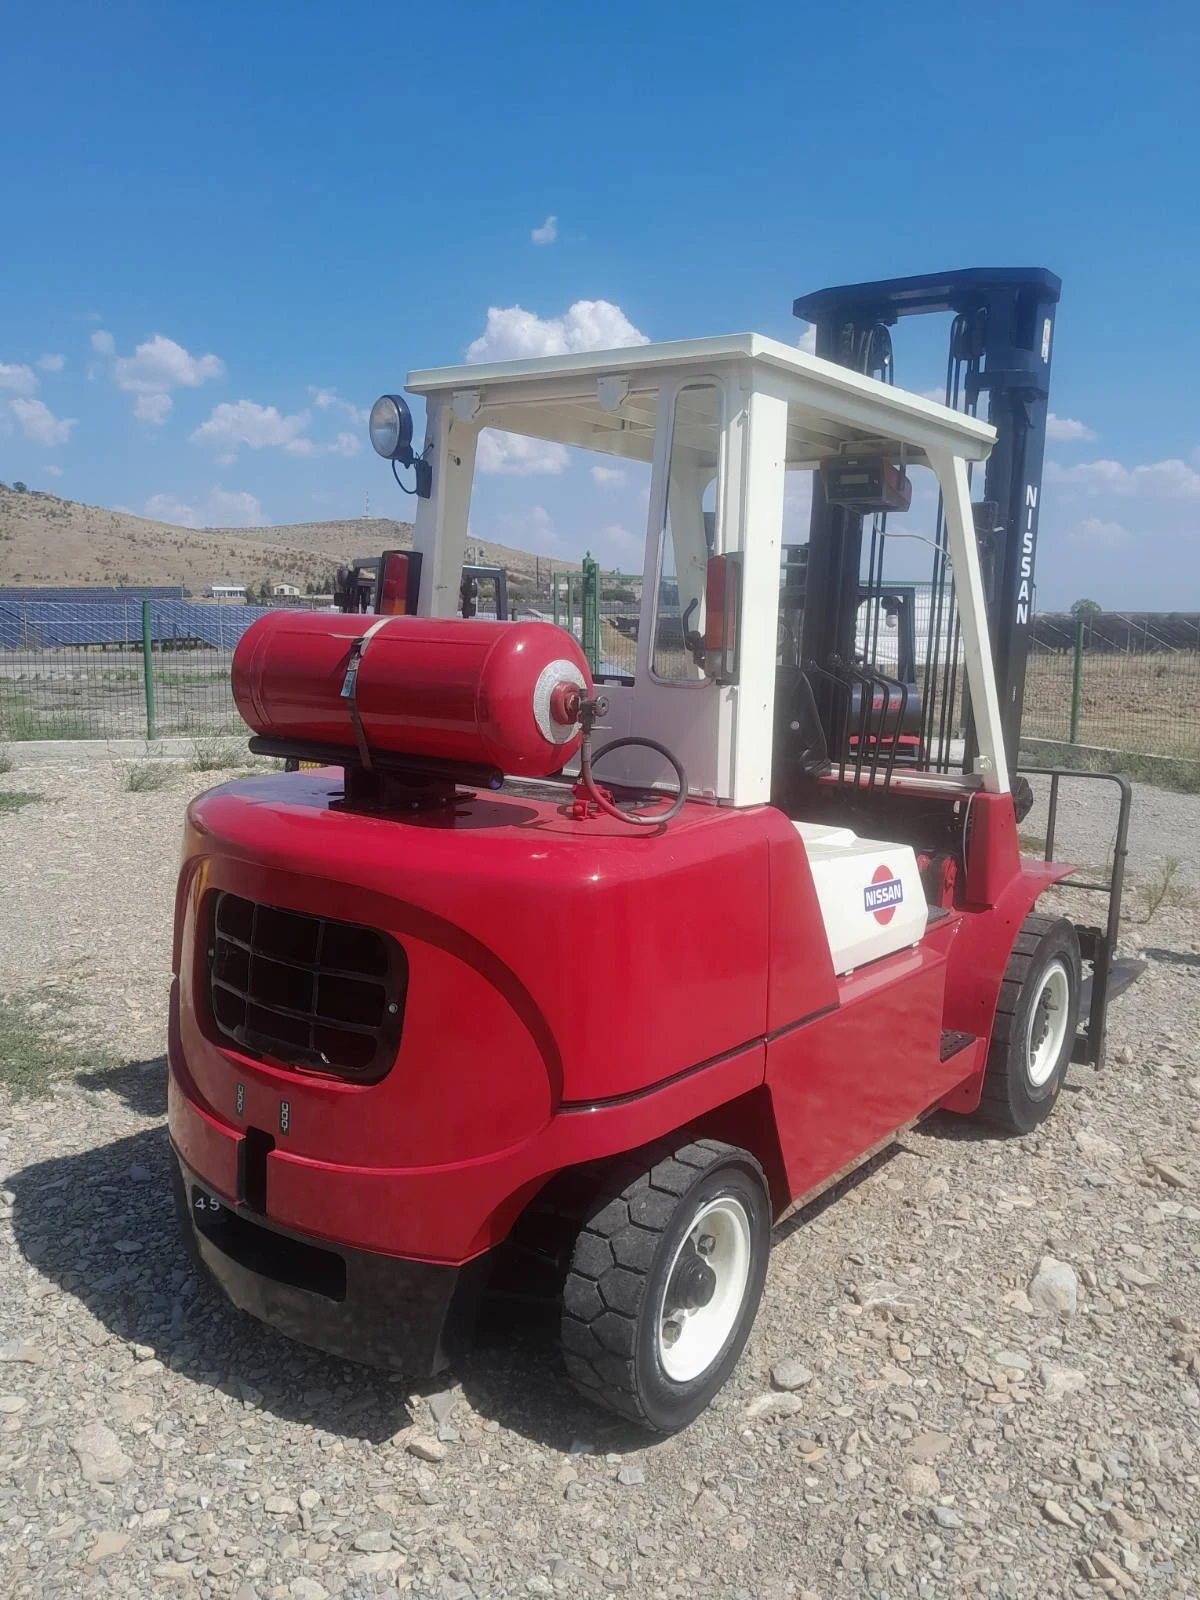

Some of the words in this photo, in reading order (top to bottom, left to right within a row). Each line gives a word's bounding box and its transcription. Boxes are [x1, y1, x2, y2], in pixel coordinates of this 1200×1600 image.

[1016, 485, 1037, 625] NISSAN
[865, 884, 901, 907] NISSAN
[194, 1198, 220, 1211] 45
